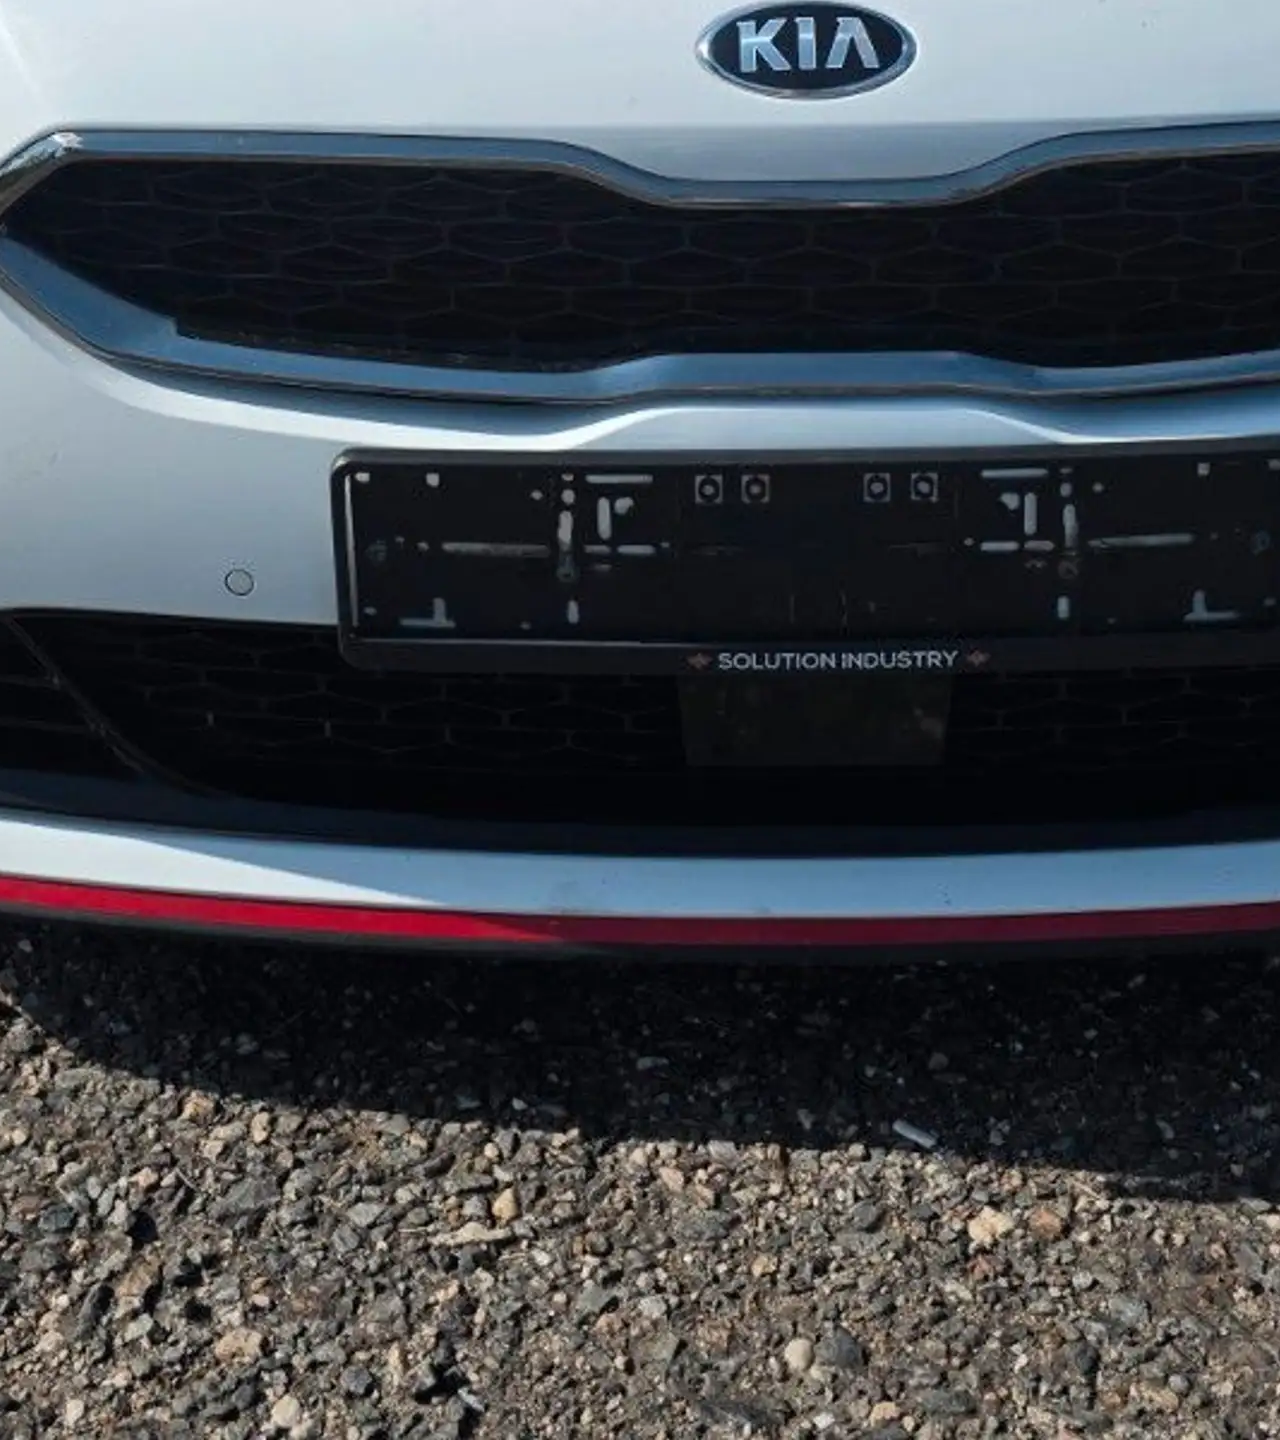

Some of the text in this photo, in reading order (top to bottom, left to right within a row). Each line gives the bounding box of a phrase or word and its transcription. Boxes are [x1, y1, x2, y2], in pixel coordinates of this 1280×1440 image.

[736, 16, 880, 73] KIA
[719, 649, 960, 670] SOLUTION INDUSTRY
